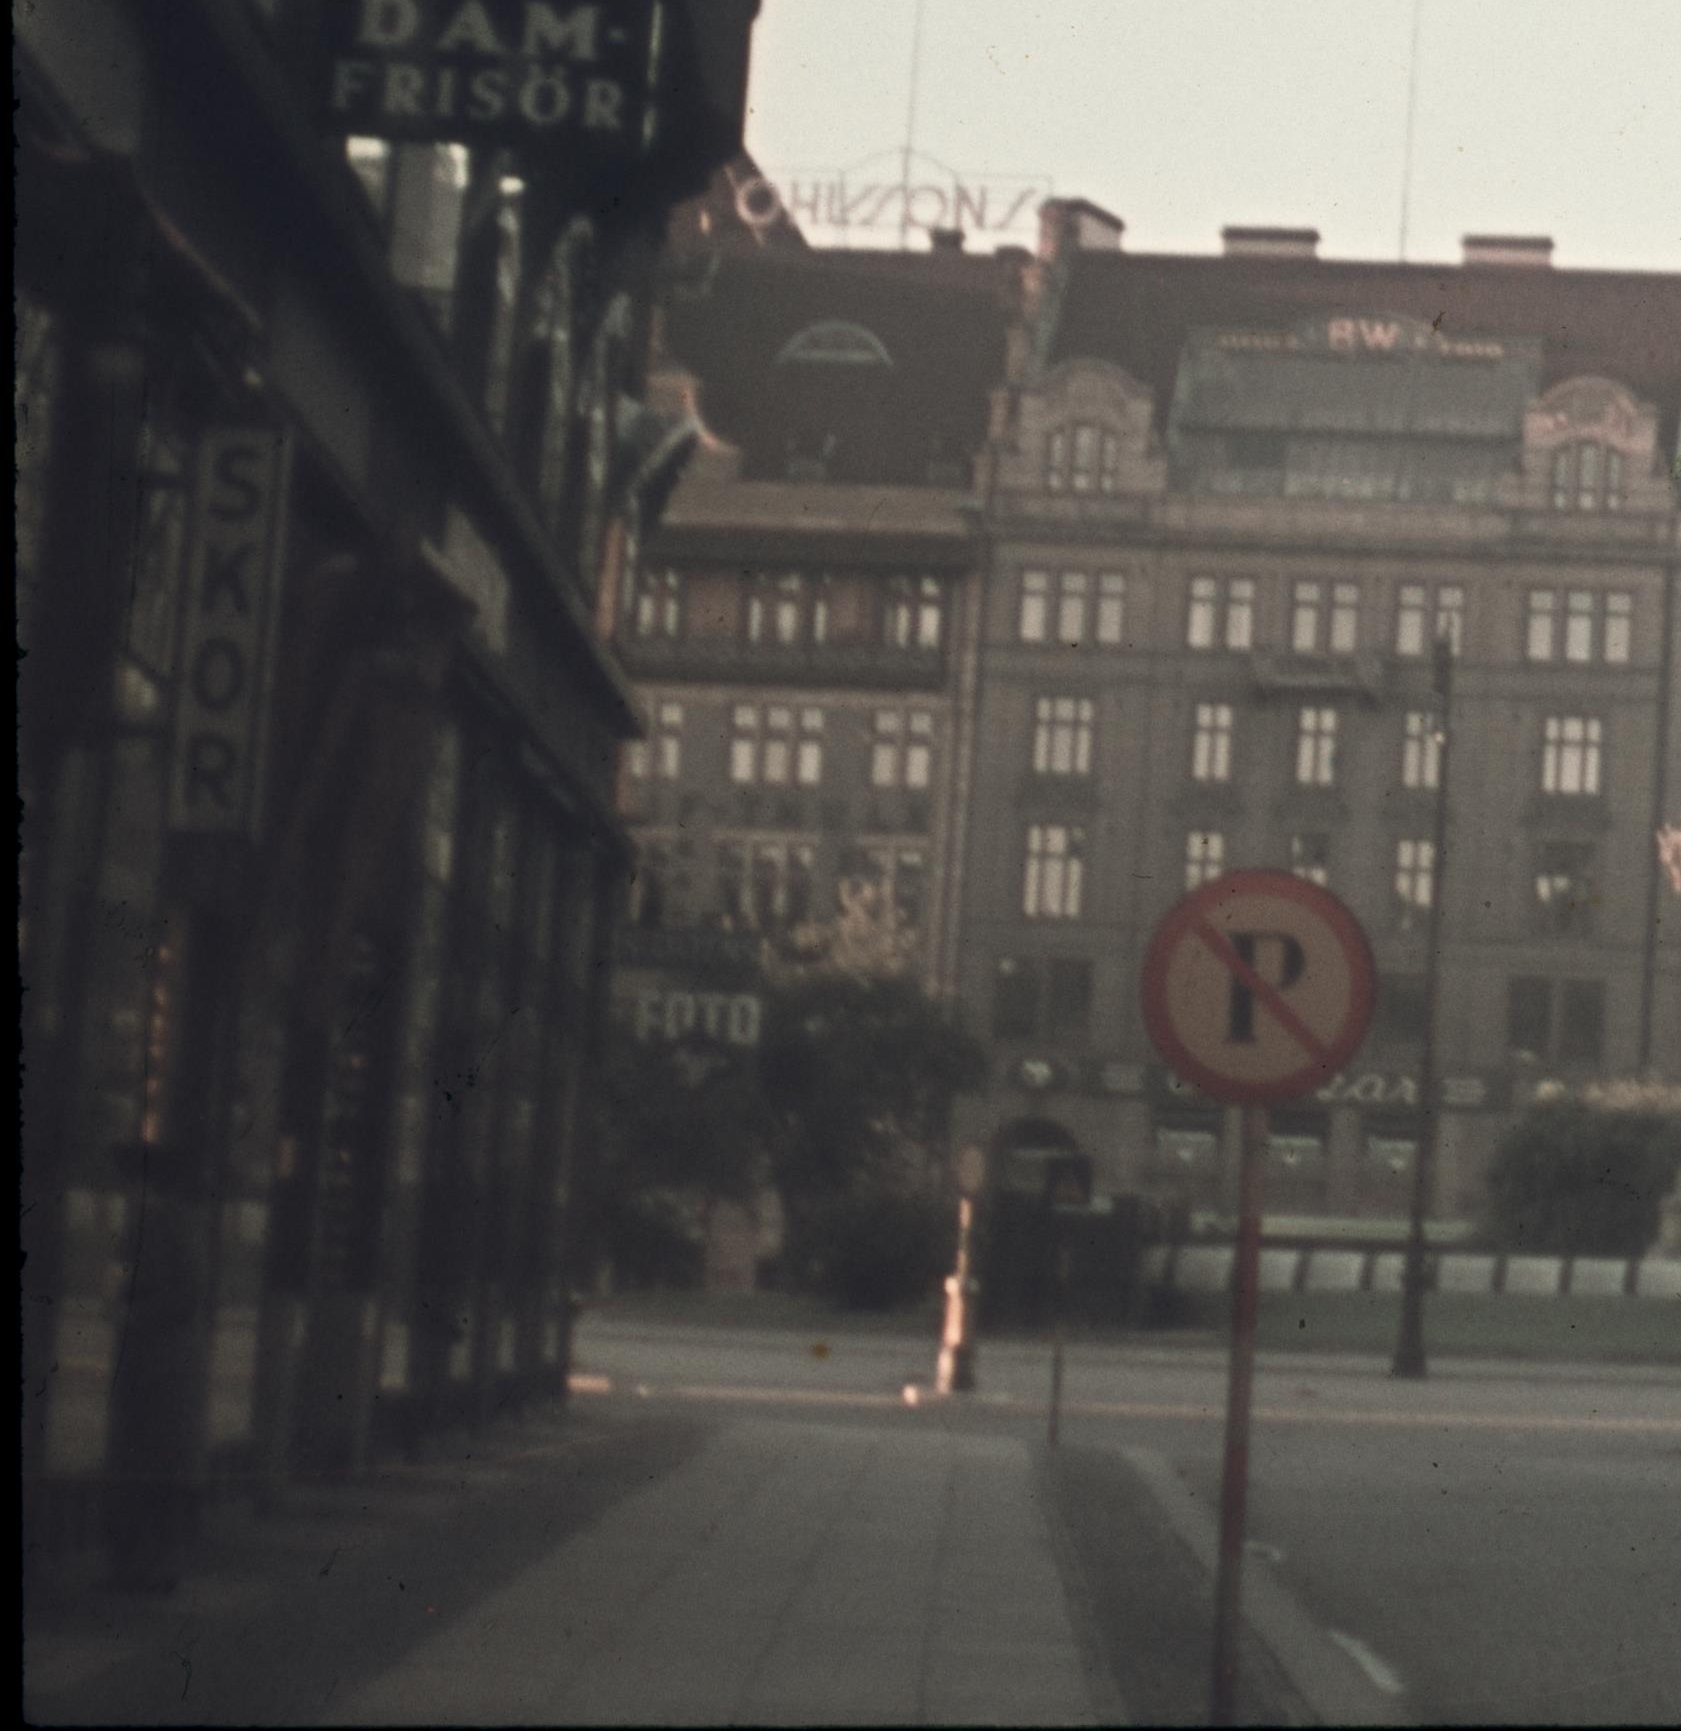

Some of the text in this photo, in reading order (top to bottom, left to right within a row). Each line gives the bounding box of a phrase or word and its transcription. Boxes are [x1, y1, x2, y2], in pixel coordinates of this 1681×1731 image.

[331, 61, 626, 131] FRISÖR
[188, 445, 260, 807] SKOR
[636, 991, 761, 1045] FOTO
[1228, 930, 1304, 1043] P
